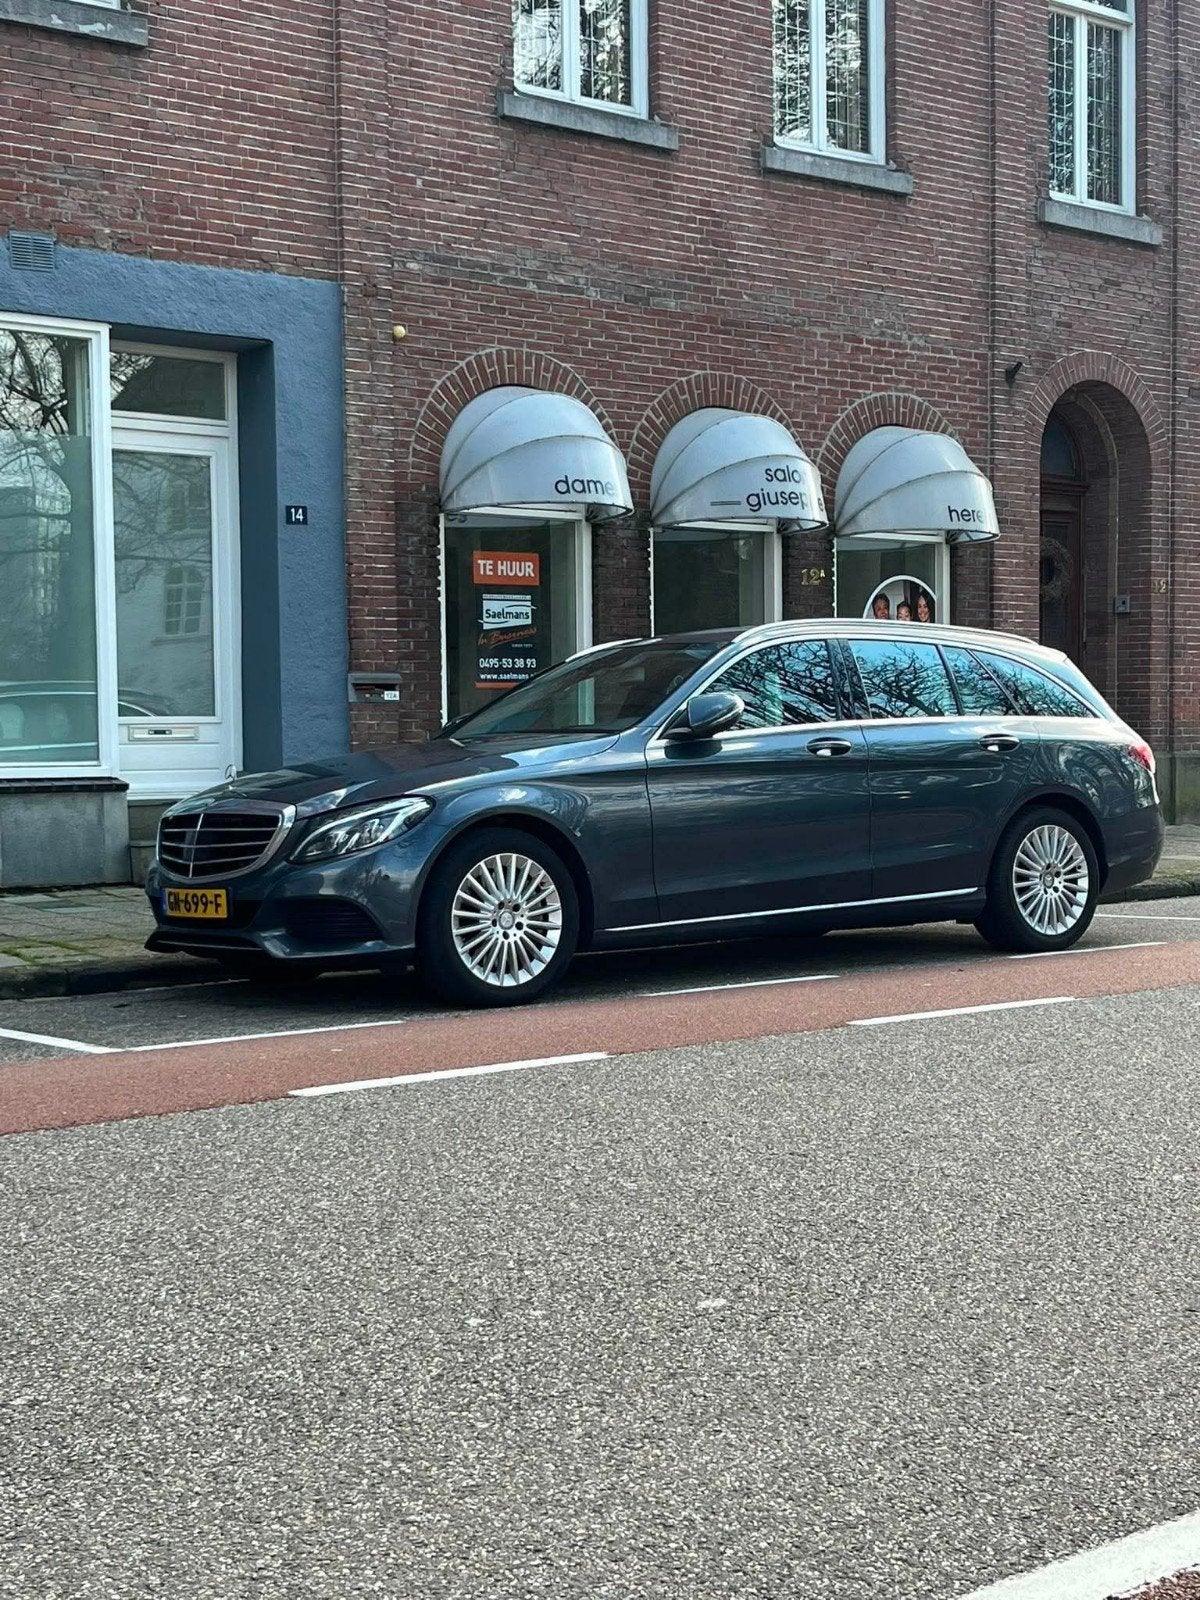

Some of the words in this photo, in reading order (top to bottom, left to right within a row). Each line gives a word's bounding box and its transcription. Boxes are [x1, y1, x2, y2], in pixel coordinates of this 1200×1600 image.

[290, 507, 304, 522] 14
[478, 560, 493, 575] TE
[497, 560, 534, 577] HUUR
[485, 608, 530, 620] Saelmans
[513, 658, 525, 668] 38
[526, 658, 537, 668] 93
[167, 891, 222, 914] GN-699-F
